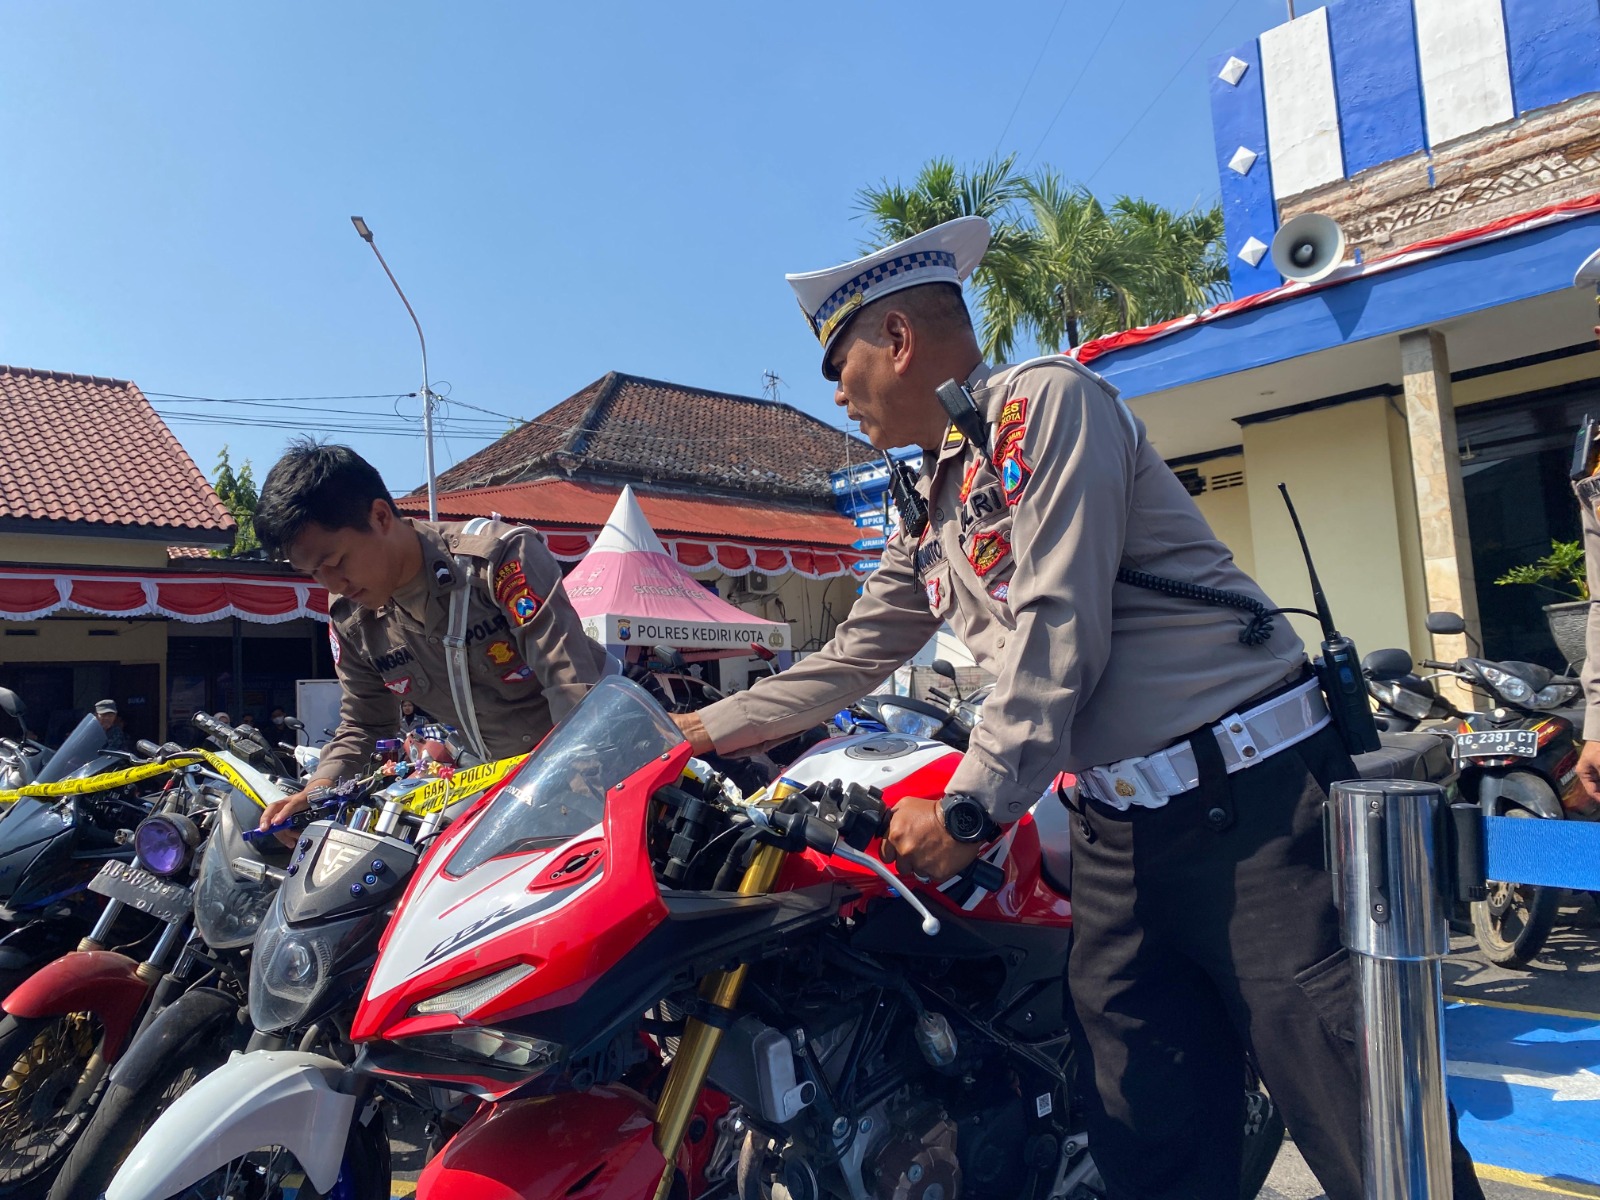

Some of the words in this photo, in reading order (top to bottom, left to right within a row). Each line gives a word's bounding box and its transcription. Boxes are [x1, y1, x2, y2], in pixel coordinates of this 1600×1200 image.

[862, 515, 885, 526] BPKB
[862, 538, 886, 547] URMIN
[637, 624, 689, 641] POLRES
[692, 626, 732, 642] KEDIRI
[734, 628, 765, 643] KOTA
[1457, 734, 1474, 746] AG
[1478, 732, 1511, 744] 2391
[1517, 732, 1535, 743] CT
[422, 774, 457, 800] GARS
[459, 761, 499, 787] POLISI
[504, 785, 533, 807] ONDA
[423, 903, 519, 962] CBR
